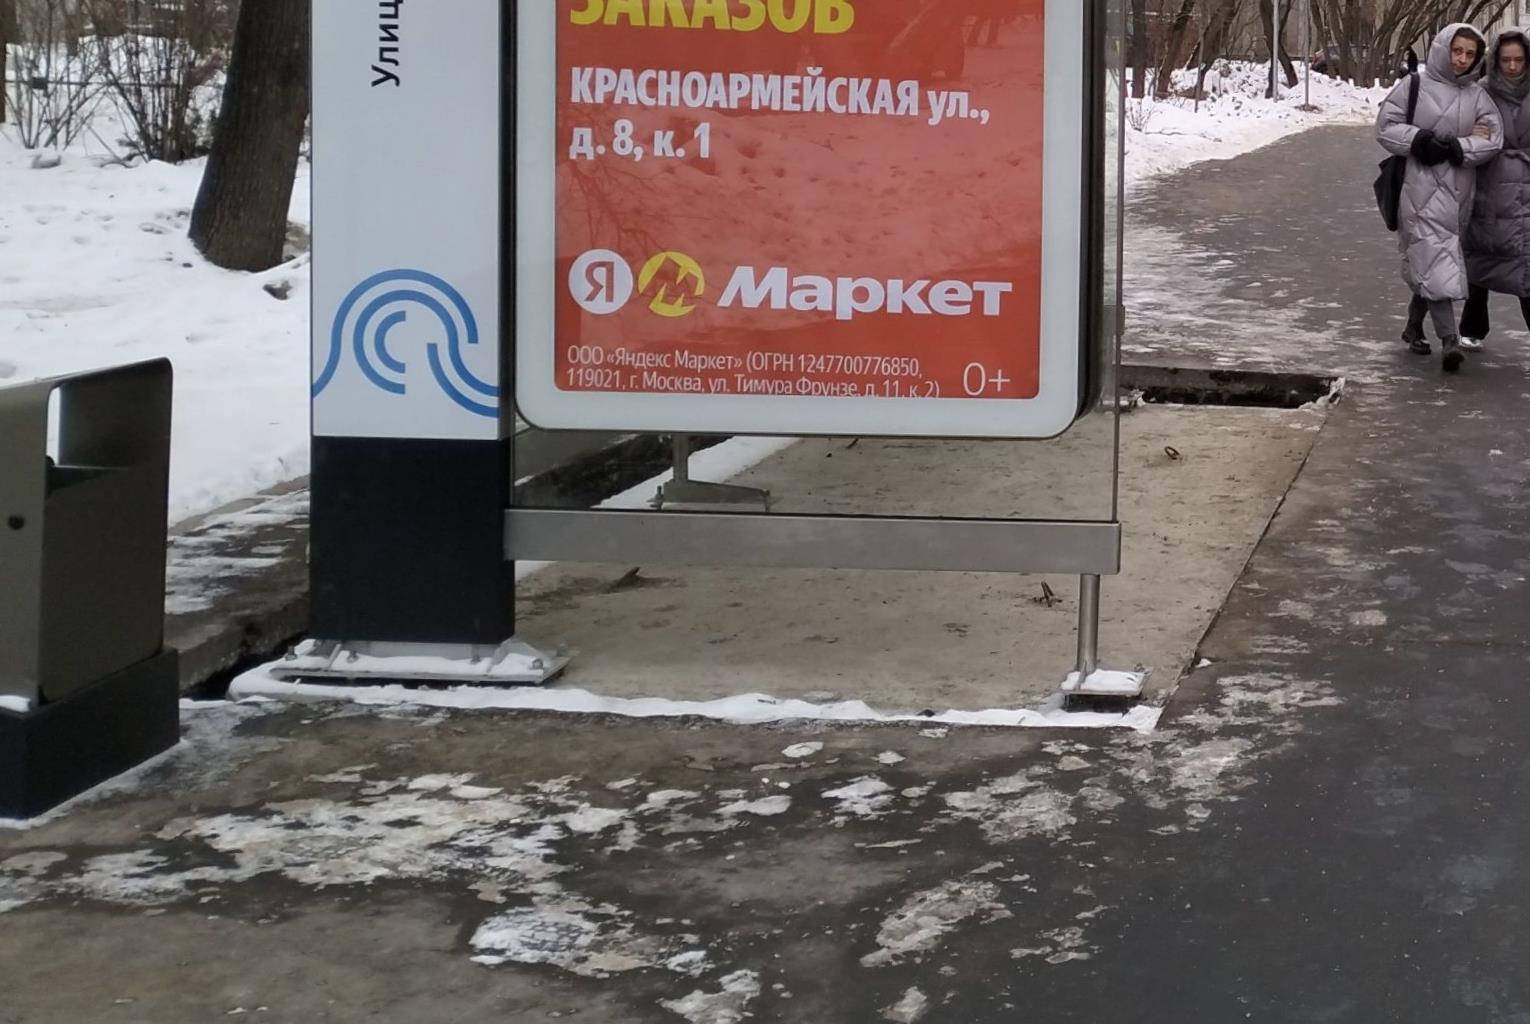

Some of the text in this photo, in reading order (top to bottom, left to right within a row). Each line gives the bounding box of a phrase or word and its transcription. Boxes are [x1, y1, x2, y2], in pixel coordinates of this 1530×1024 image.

[571, 66, 991, 125] КРАСНОАРМЕЙСКАЯ ул.,
[569, 119, 711, 162] д. 8, к. 1
[717, 265, 1013, 320] Маркет
[567, 344, 922, 378] ООО «Яндекс Маркет» (ОГРН 1247700776850,
[962, 361, 1011, 396] 0+
[566, 367, 626, 390] 119021,
[629, 374, 640, 390] г.
[707, 378, 731, 394] ул.
[734, 374, 791, 394] Тимура
[924, 380, 941, 397] 2)
